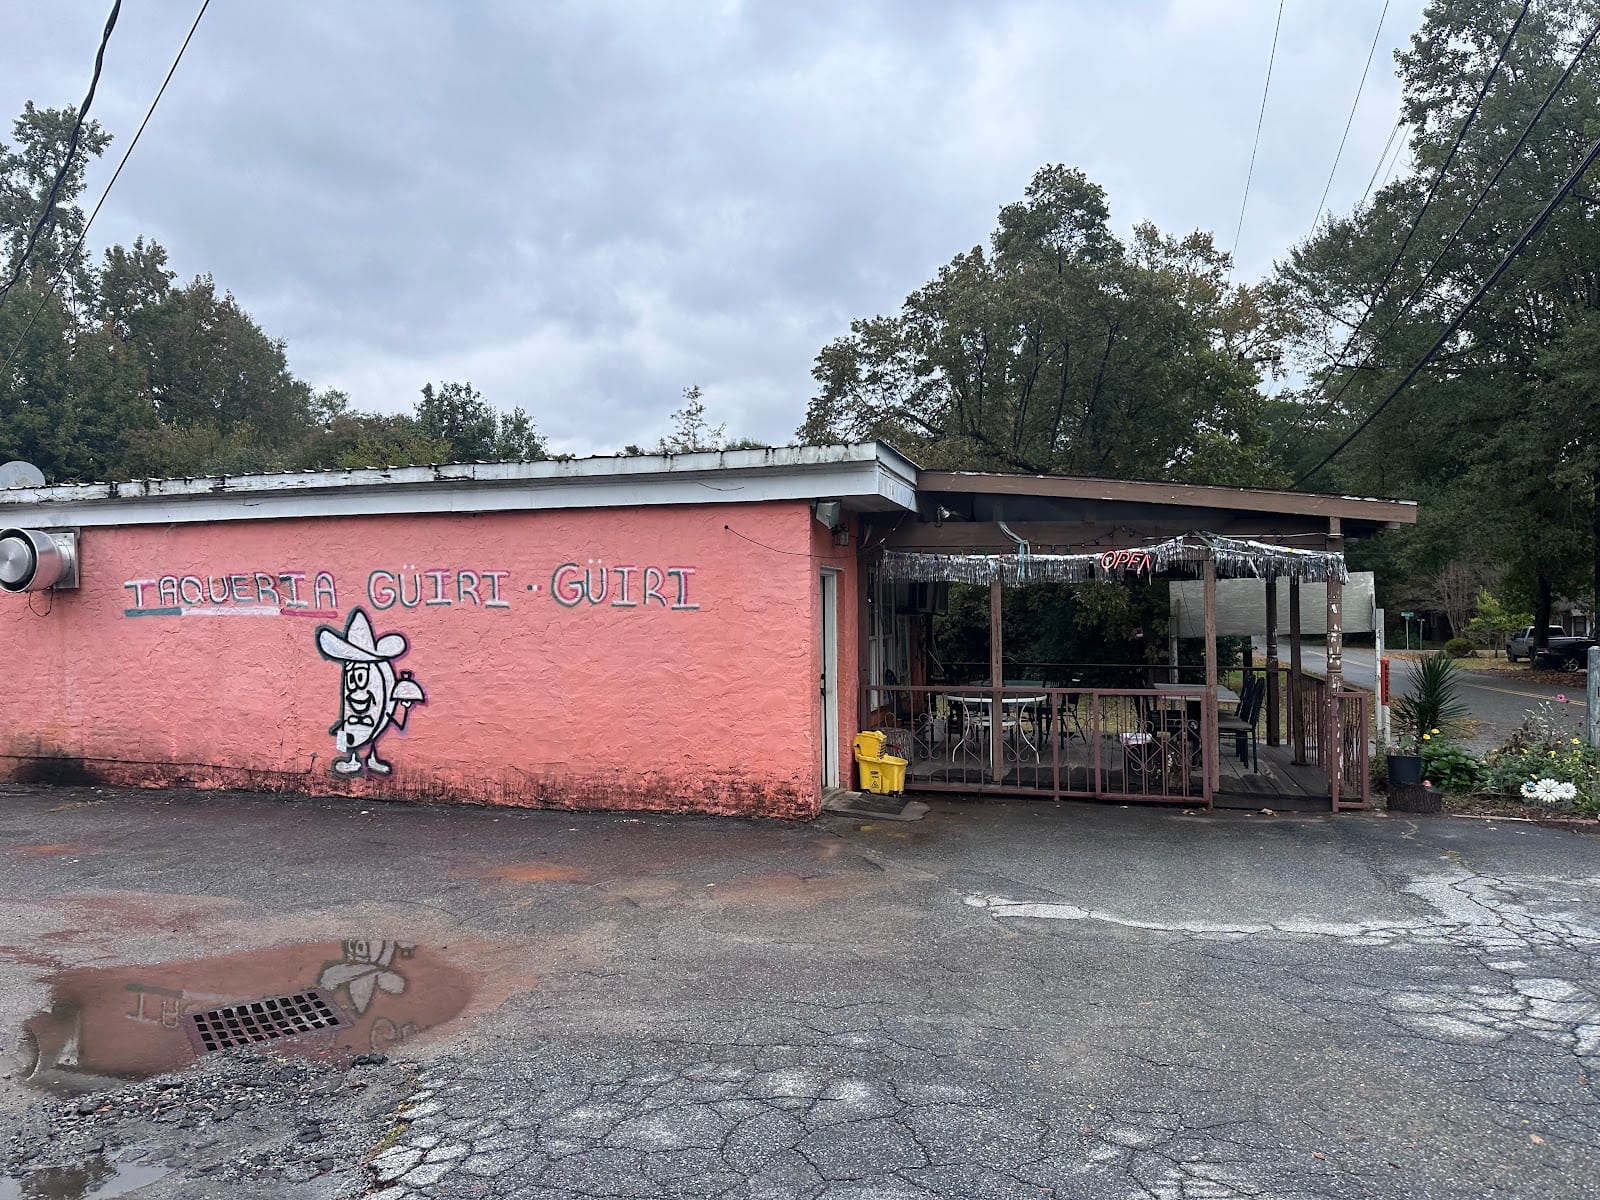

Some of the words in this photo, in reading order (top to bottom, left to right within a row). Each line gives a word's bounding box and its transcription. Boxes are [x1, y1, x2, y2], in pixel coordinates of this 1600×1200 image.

[1101, 550, 1157, 572] OPEN
[124, 570, 338, 609] TAQUERIA
[367, 564, 511, 610] GÜIRI
[551, 558, 700, 611] GÜIRI
